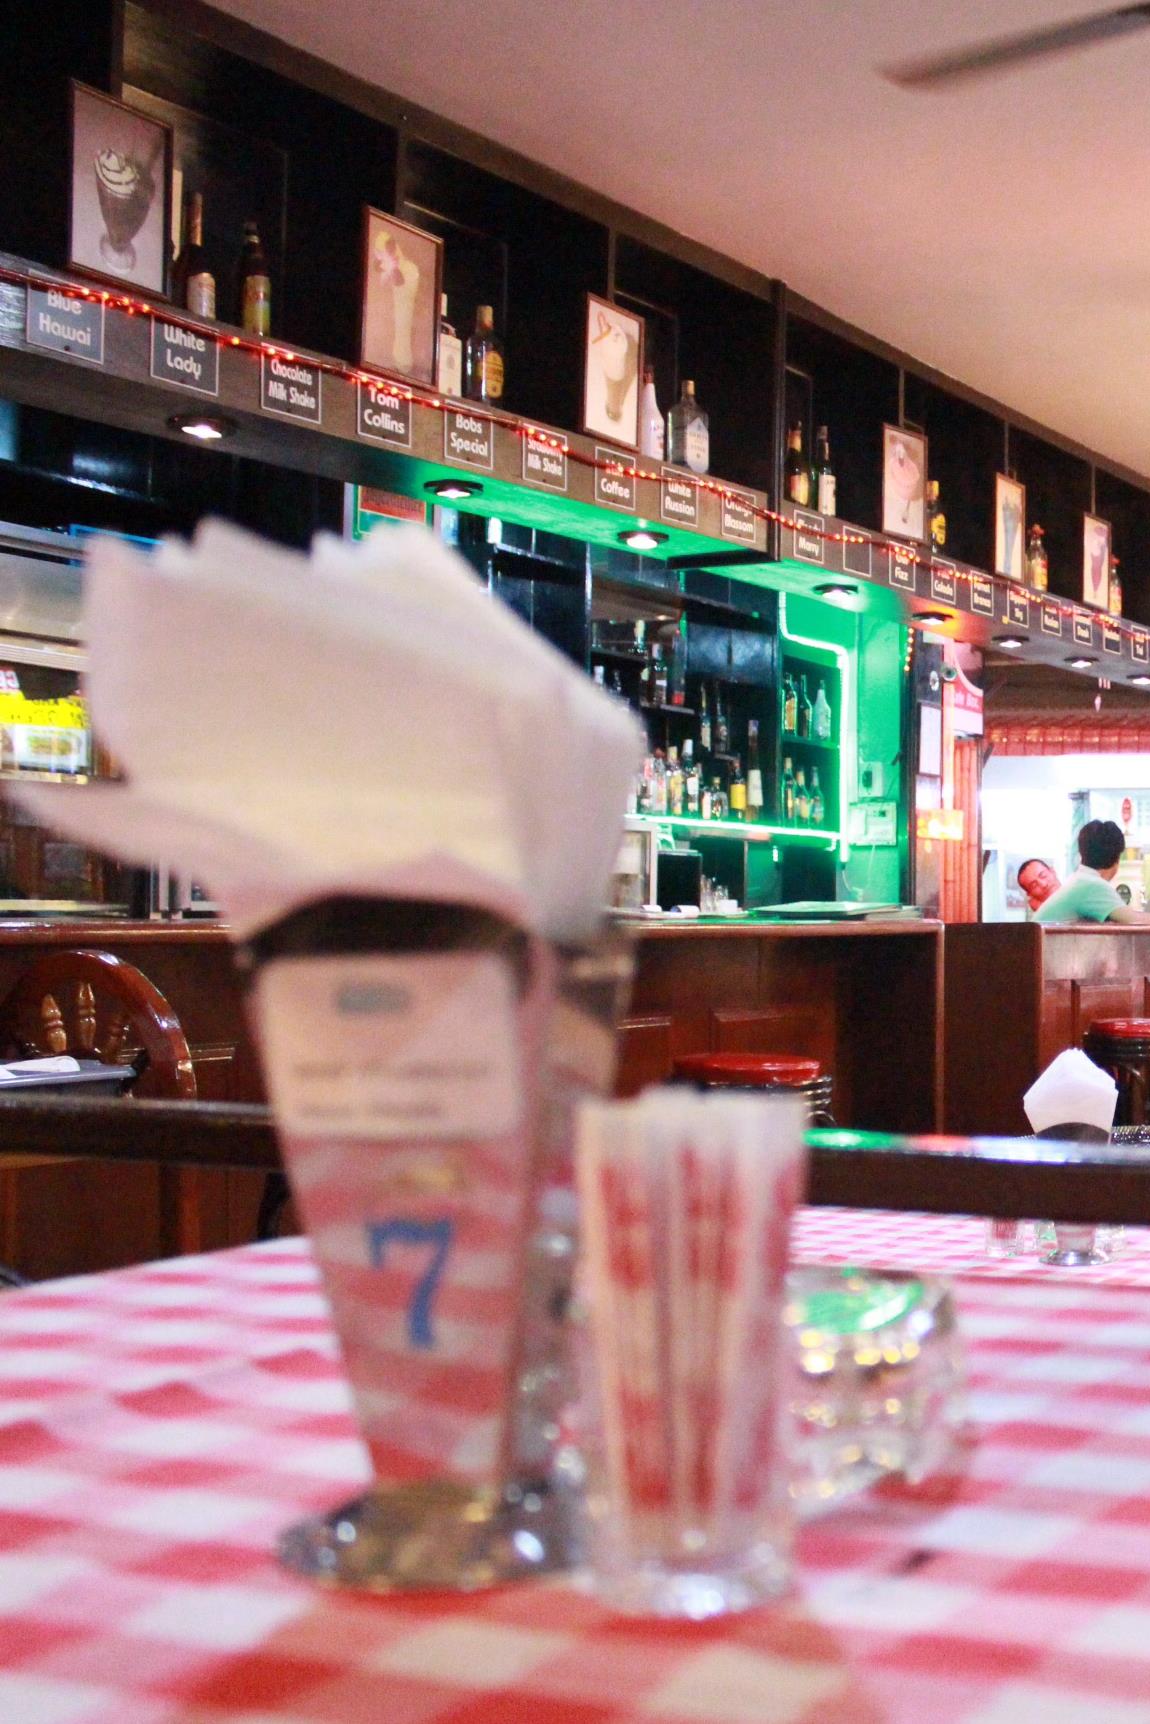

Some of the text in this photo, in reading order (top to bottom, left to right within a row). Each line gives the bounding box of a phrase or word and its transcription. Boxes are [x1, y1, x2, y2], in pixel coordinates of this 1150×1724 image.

[47, 288, 82, 315] Blue
[39, 312, 91, 346] Hawai
[163, 323, 206, 352] White
[166, 349, 202, 380] Lady
[270, 358, 313, 386] Chocolate
[268, 380, 316, 409] Milk Shake
[368, 384, 400, 410] Tom
[364, 409, 406, 434] Collins
[456, 413, 482, 434] Bobs
[450, 432, 488, 456] Special
[600, 477, 630, 498] Coffee
[665, 496, 695, 517] Russian
[369, 1217, 453, 1349] 7
